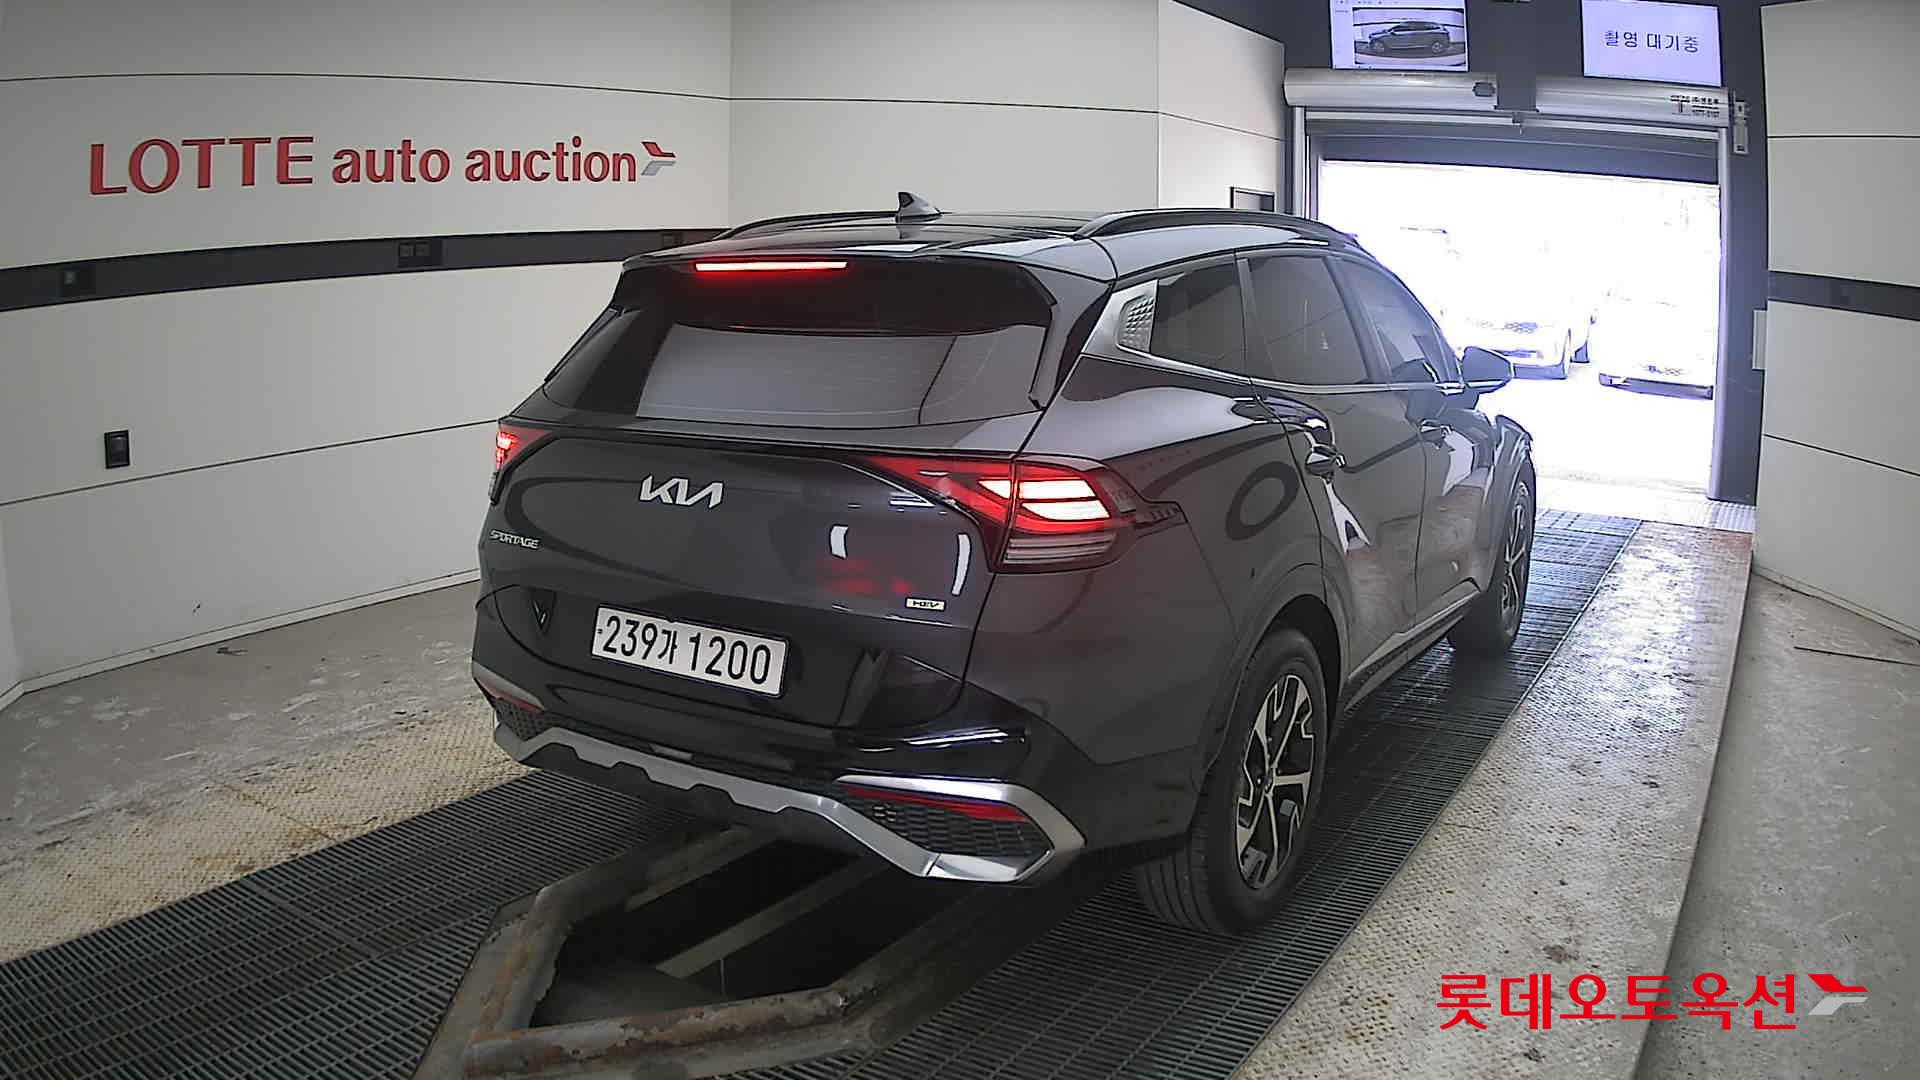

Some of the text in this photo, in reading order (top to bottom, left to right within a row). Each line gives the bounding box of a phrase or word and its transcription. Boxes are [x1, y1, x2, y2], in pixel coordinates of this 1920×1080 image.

[1604, 30, 1698, 53] 촬영 대기중
[90, 135, 638, 195] LOTTE auto auction
[639, 474, 724, 509] KIA
[602, 615, 772, 685] 239가 1200
